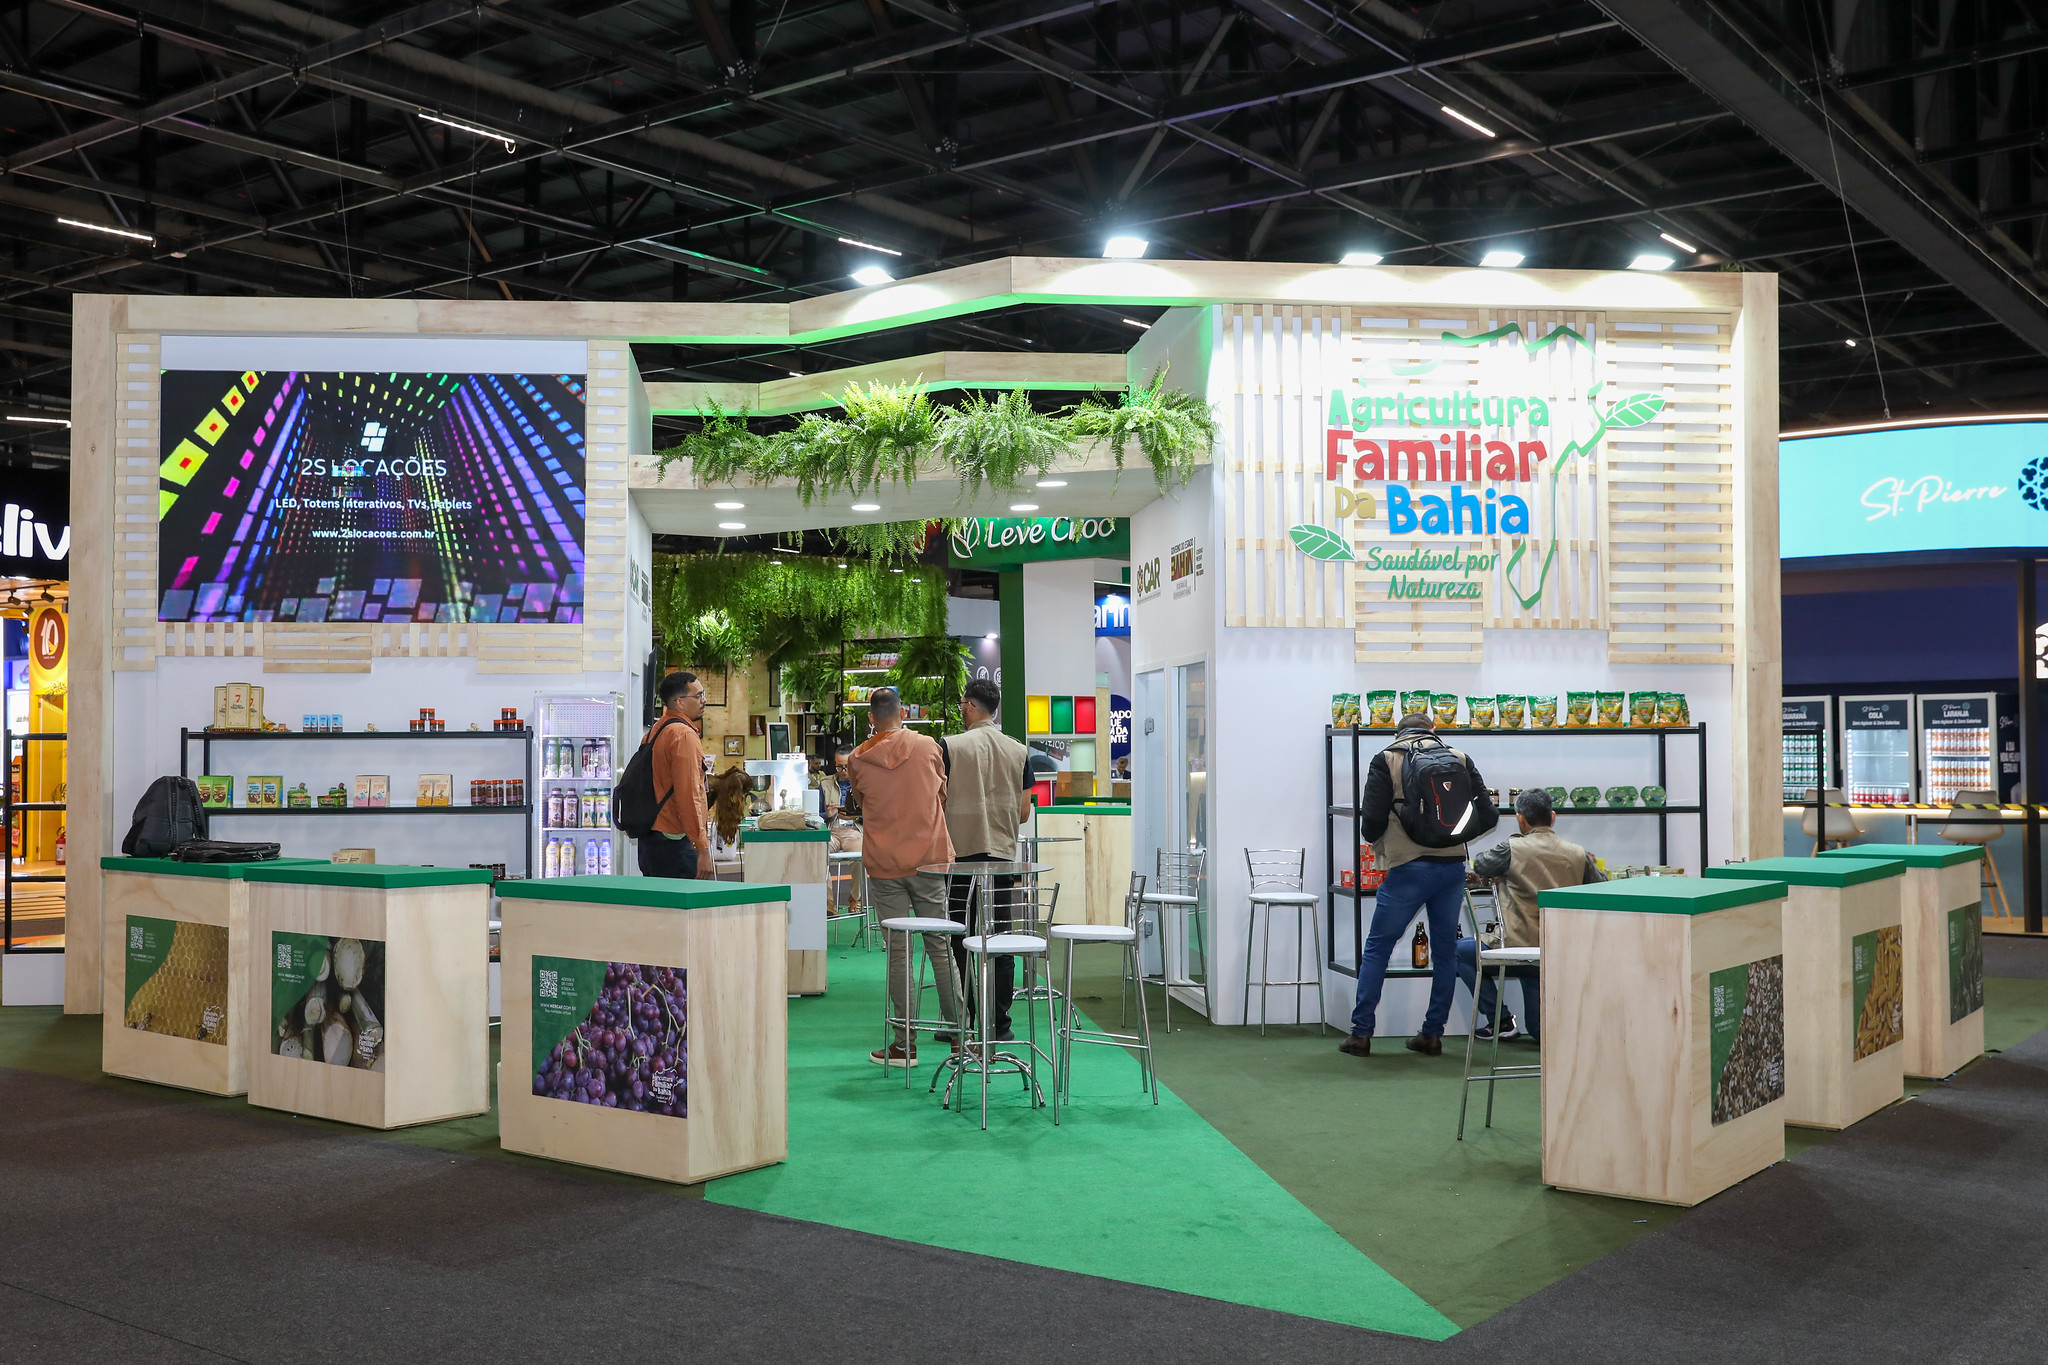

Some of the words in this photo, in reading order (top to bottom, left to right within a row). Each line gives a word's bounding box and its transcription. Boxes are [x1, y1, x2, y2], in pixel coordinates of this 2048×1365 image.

[1328, 389, 1549, 432] Agricultura
[301, 459, 326, 476] 2S
[1326, 429, 1547, 482] Familiar
[275, 498, 300, 510] LED,
[303, 498, 340, 509] Totens
[343, 498, 404, 510] Interativos,
[407, 498, 430, 510] TVs,
[431, 498, 472, 509] Tablets
[1910, 475, 2008, 513] Pierre
[1385, 484, 1529, 534] Bahia
[312, 528, 436, 540] www.2slocacoes.com.br
[987, 521, 1046, 549] Leve
[1365, 545, 1464, 572] Saudável
[1464, 552, 1500, 577] por
[1144, 557, 1160, 593] CAR
[1388, 574, 1482, 599] Natureza
[1110, 718, 1122, 727] UE
[1943, 710, 1969, 718] LARANJA
[1110, 735, 1128, 744] NTE
